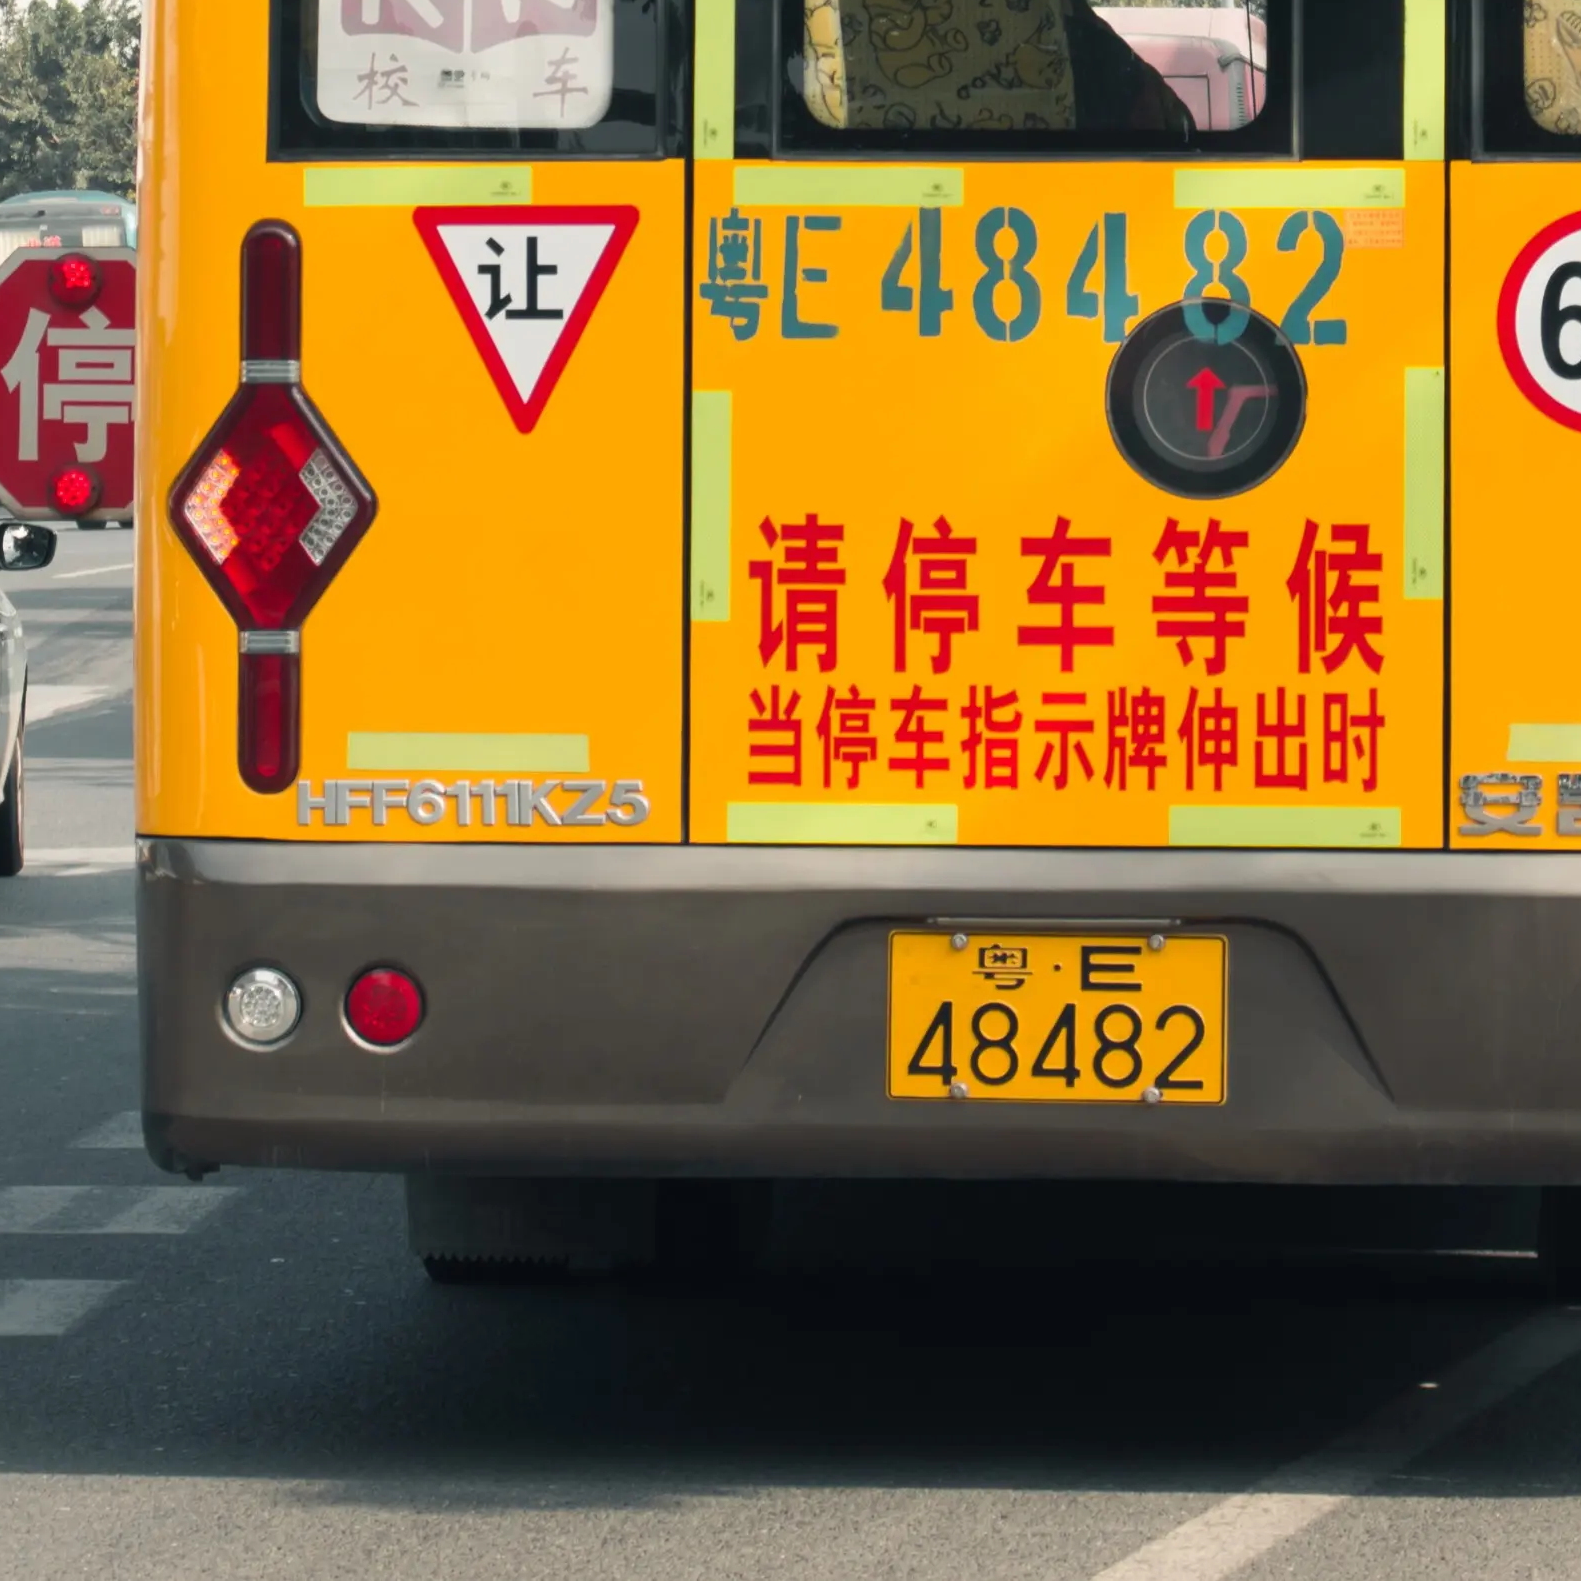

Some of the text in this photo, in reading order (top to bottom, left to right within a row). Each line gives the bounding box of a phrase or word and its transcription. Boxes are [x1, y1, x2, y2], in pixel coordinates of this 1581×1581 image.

[477, 236, 564, 320] 让
[0, 306, 136, 463] 停
[748, 513, 1385, 676] 请停车等候
[747, 684, 1386, 792] 当停车指示牌伸出时
[297, 779, 650, 826] HFF6111KZ5
[908, 1001, 1205, 1090] 48482
